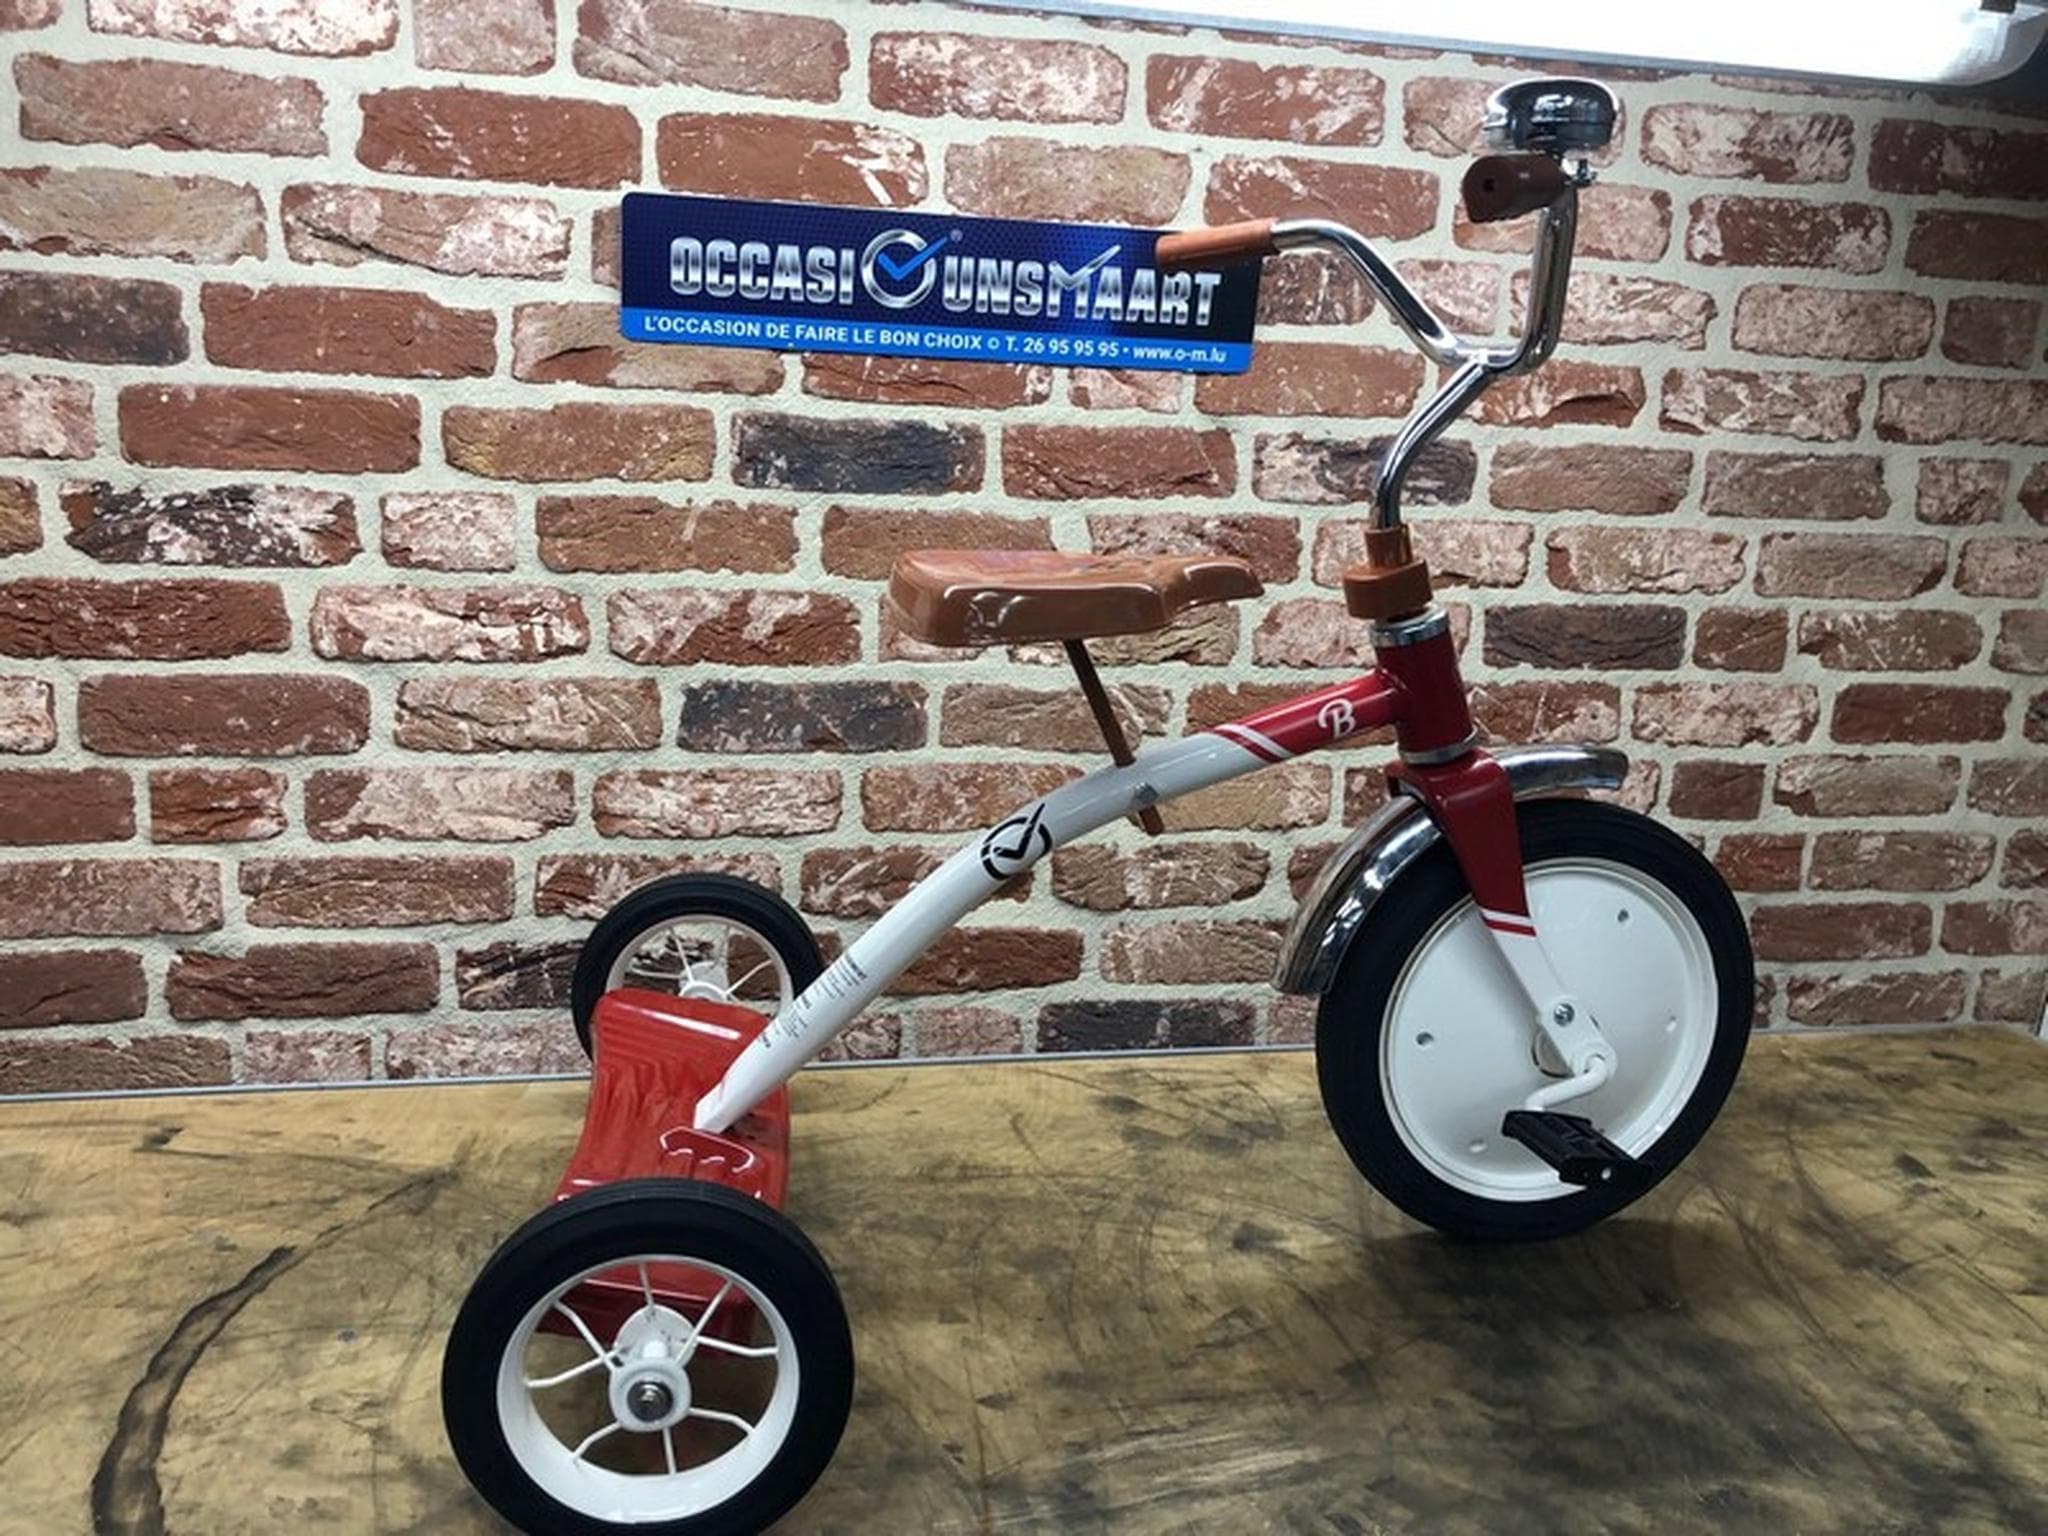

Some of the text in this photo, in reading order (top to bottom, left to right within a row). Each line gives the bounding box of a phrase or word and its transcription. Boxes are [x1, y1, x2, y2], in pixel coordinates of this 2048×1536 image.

[644, 316, 1227, 363] L'OCCASION DE FAIRE LE BON CHOIX T. 26 95 95 95 www.o-m.lu
[1318, 698, 1356, 739] B
